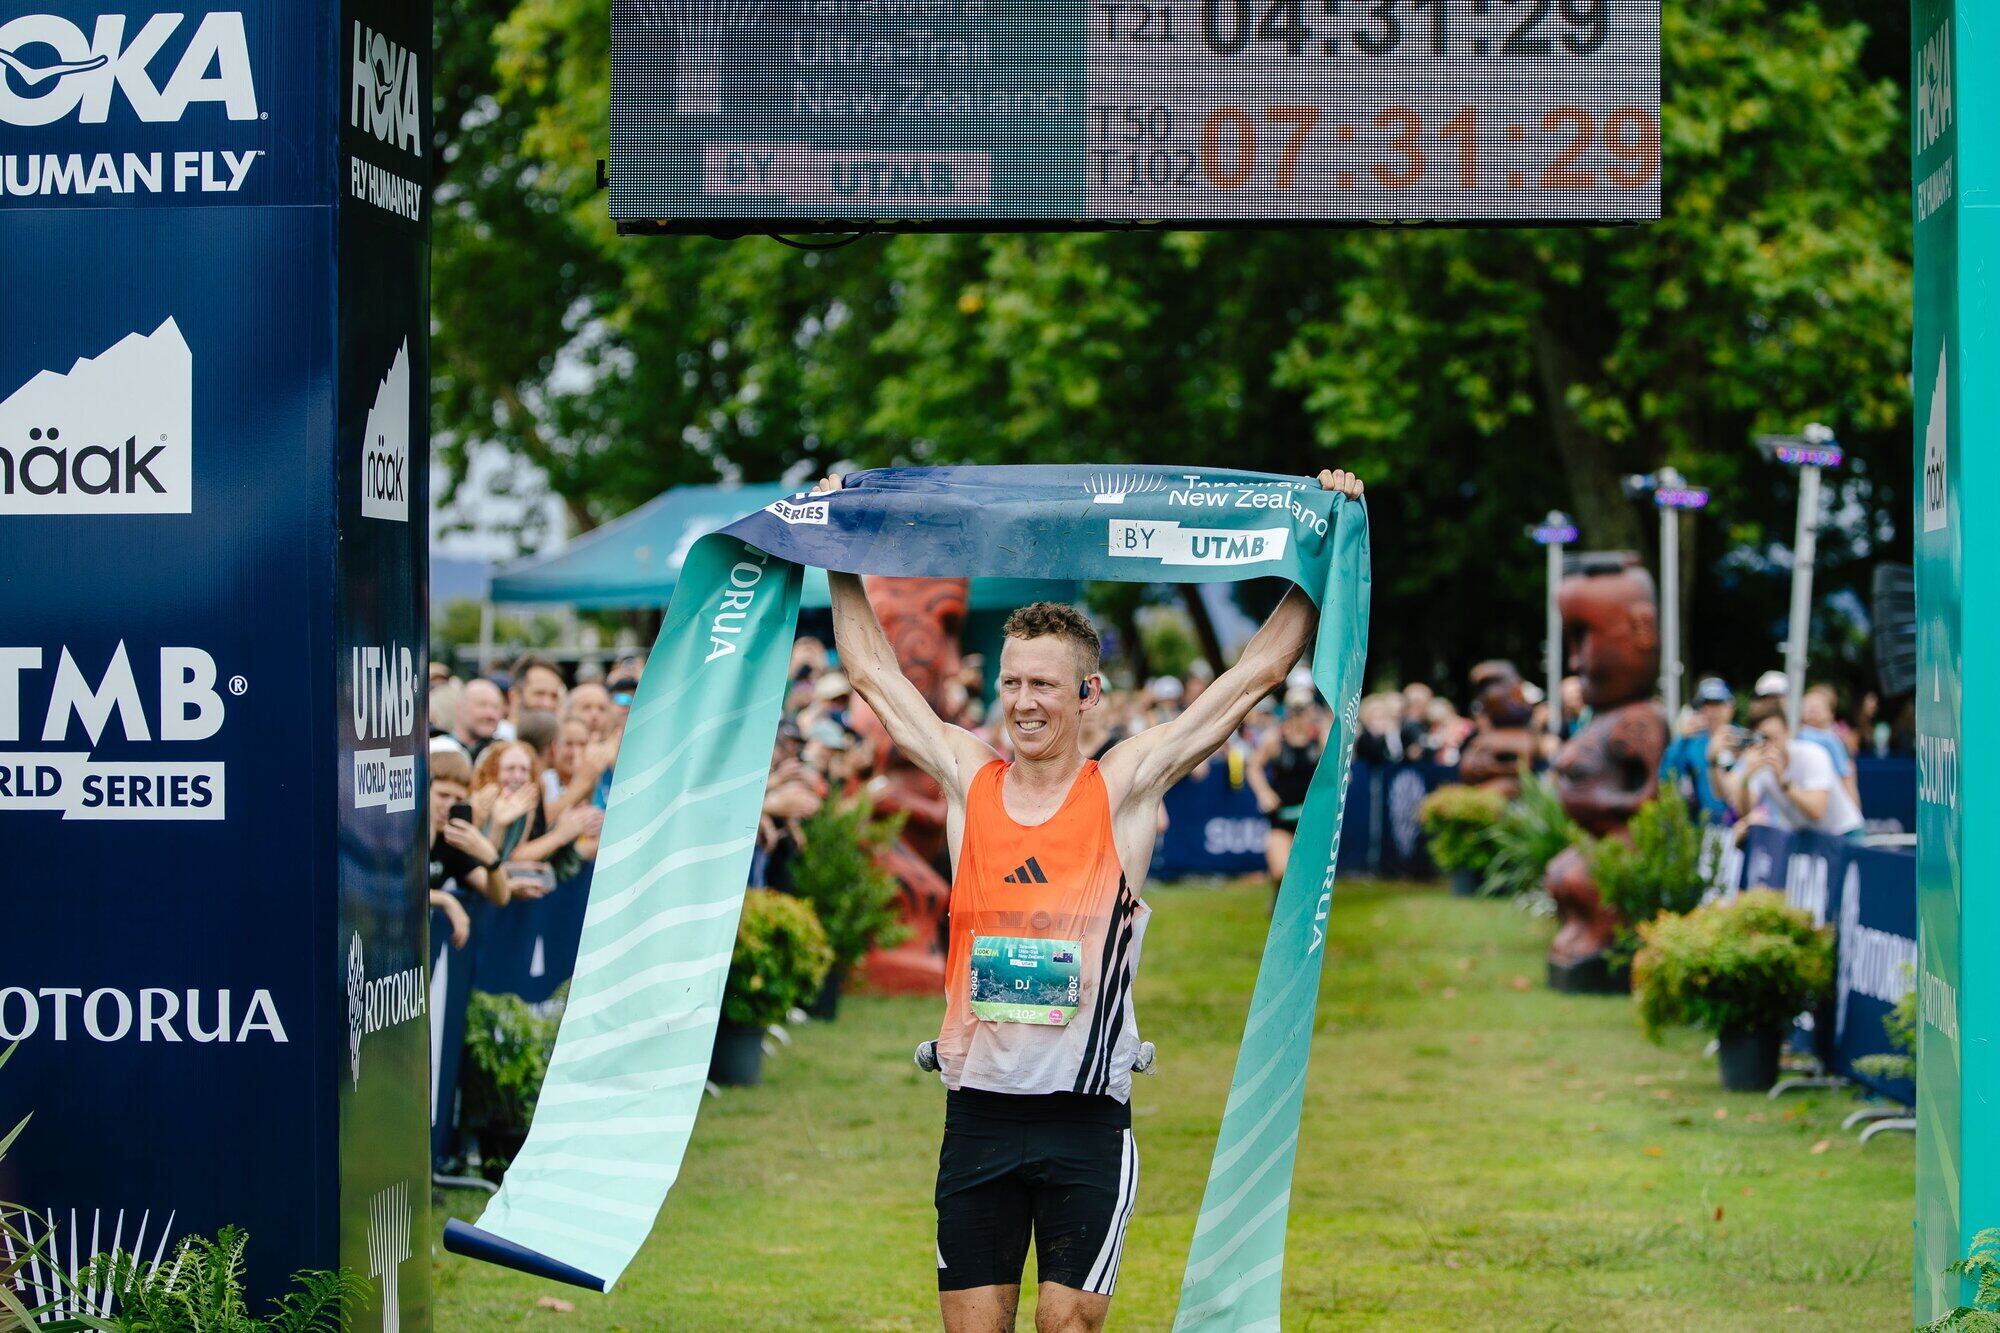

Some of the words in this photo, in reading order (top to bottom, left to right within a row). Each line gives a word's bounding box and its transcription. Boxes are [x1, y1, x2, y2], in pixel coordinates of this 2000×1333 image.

[1098, 5, 1176, 41] T21
[1201, 0, 1610, 57] 04:31:29
[352, 20, 422, 157] HOKA
[793, 80, 886, 116] New
[898, 80, 1066, 116] Zealand
[1917, 17, 1952, 156] HOKA
[1091, 106, 1173, 142] T50
[1091, 150, 1196, 187] T102
[1201, 105, 1658, 190] 07:31:29
[0, 153, 162, 195] UMAN
[352, 156, 369, 200] FLY
[369, 163, 406, 216] HUMAN
[726, 152, 775, 185] BY
[831, 161, 956, 197] UTMB
[368, 434, 404, 502] näak
[774, 502, 824, 520] SERIES
[1168, 489, 1230, 507] New
[1234, 489, 1329, 538] Zealand
[1125, 528, 1156, 549] BY
[1192, 535, 1266, 560] UTMB
[81, 774, 213, 808] SERIES
[357, 762, 387, 796] WORLD
[389, 767, 414, 801] SERIES
[1919, 733, 1957, 810] SUUNTO
[365, 965, 426, 1035] ROTORUA
[1015, 979, 1030, 990] DJ
[1068, 976, 1078, 1002] 2002
